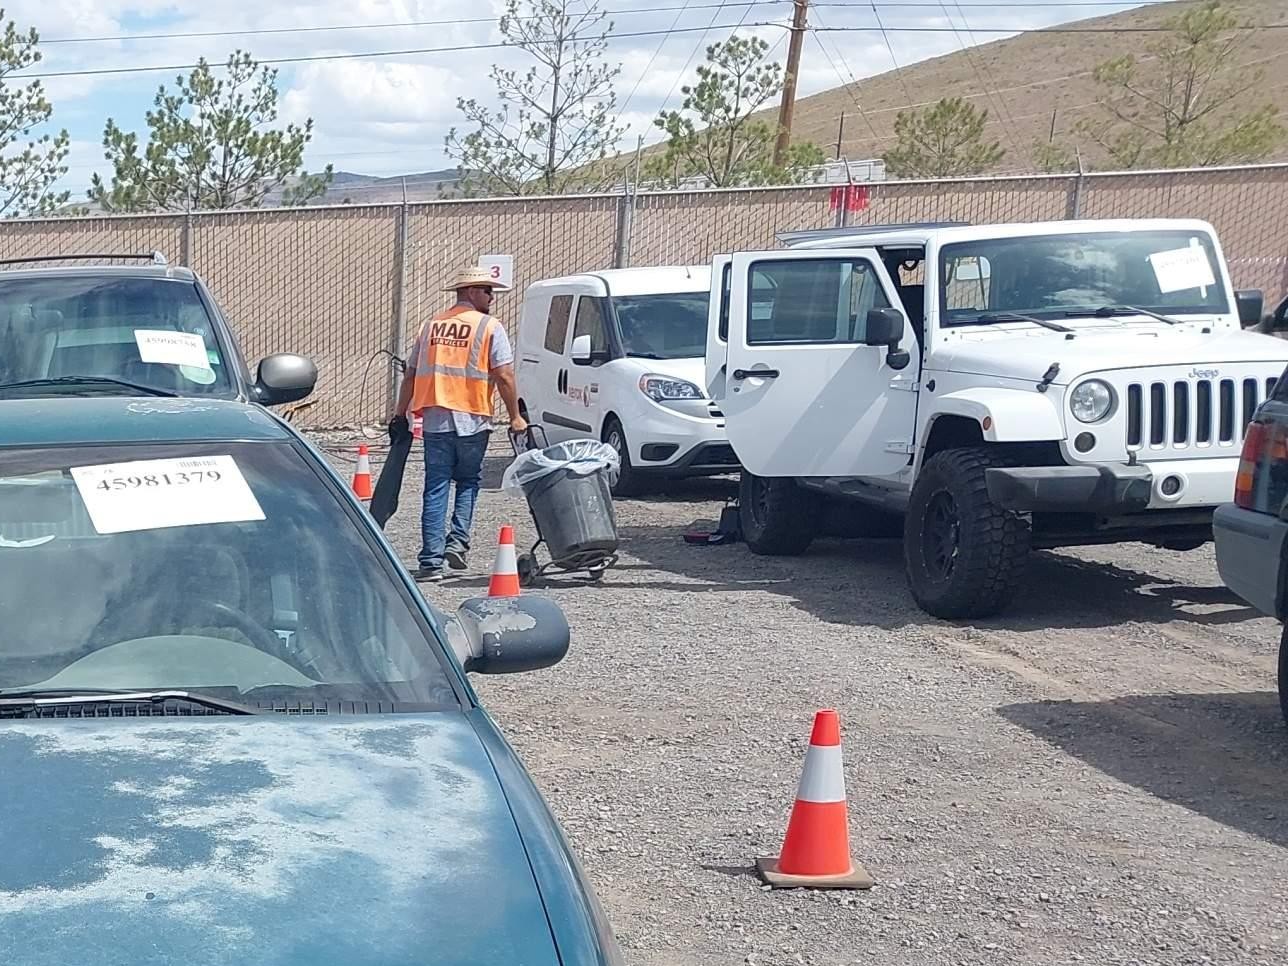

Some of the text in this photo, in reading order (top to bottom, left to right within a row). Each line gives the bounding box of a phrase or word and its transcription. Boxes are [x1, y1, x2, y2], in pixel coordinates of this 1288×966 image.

[490, 265, 500, 279] 3
[431, 322, 472, 340] MAD
[1188, 367, 1220, 380] Jeep
[96, 470, 222, 492] 45981379
